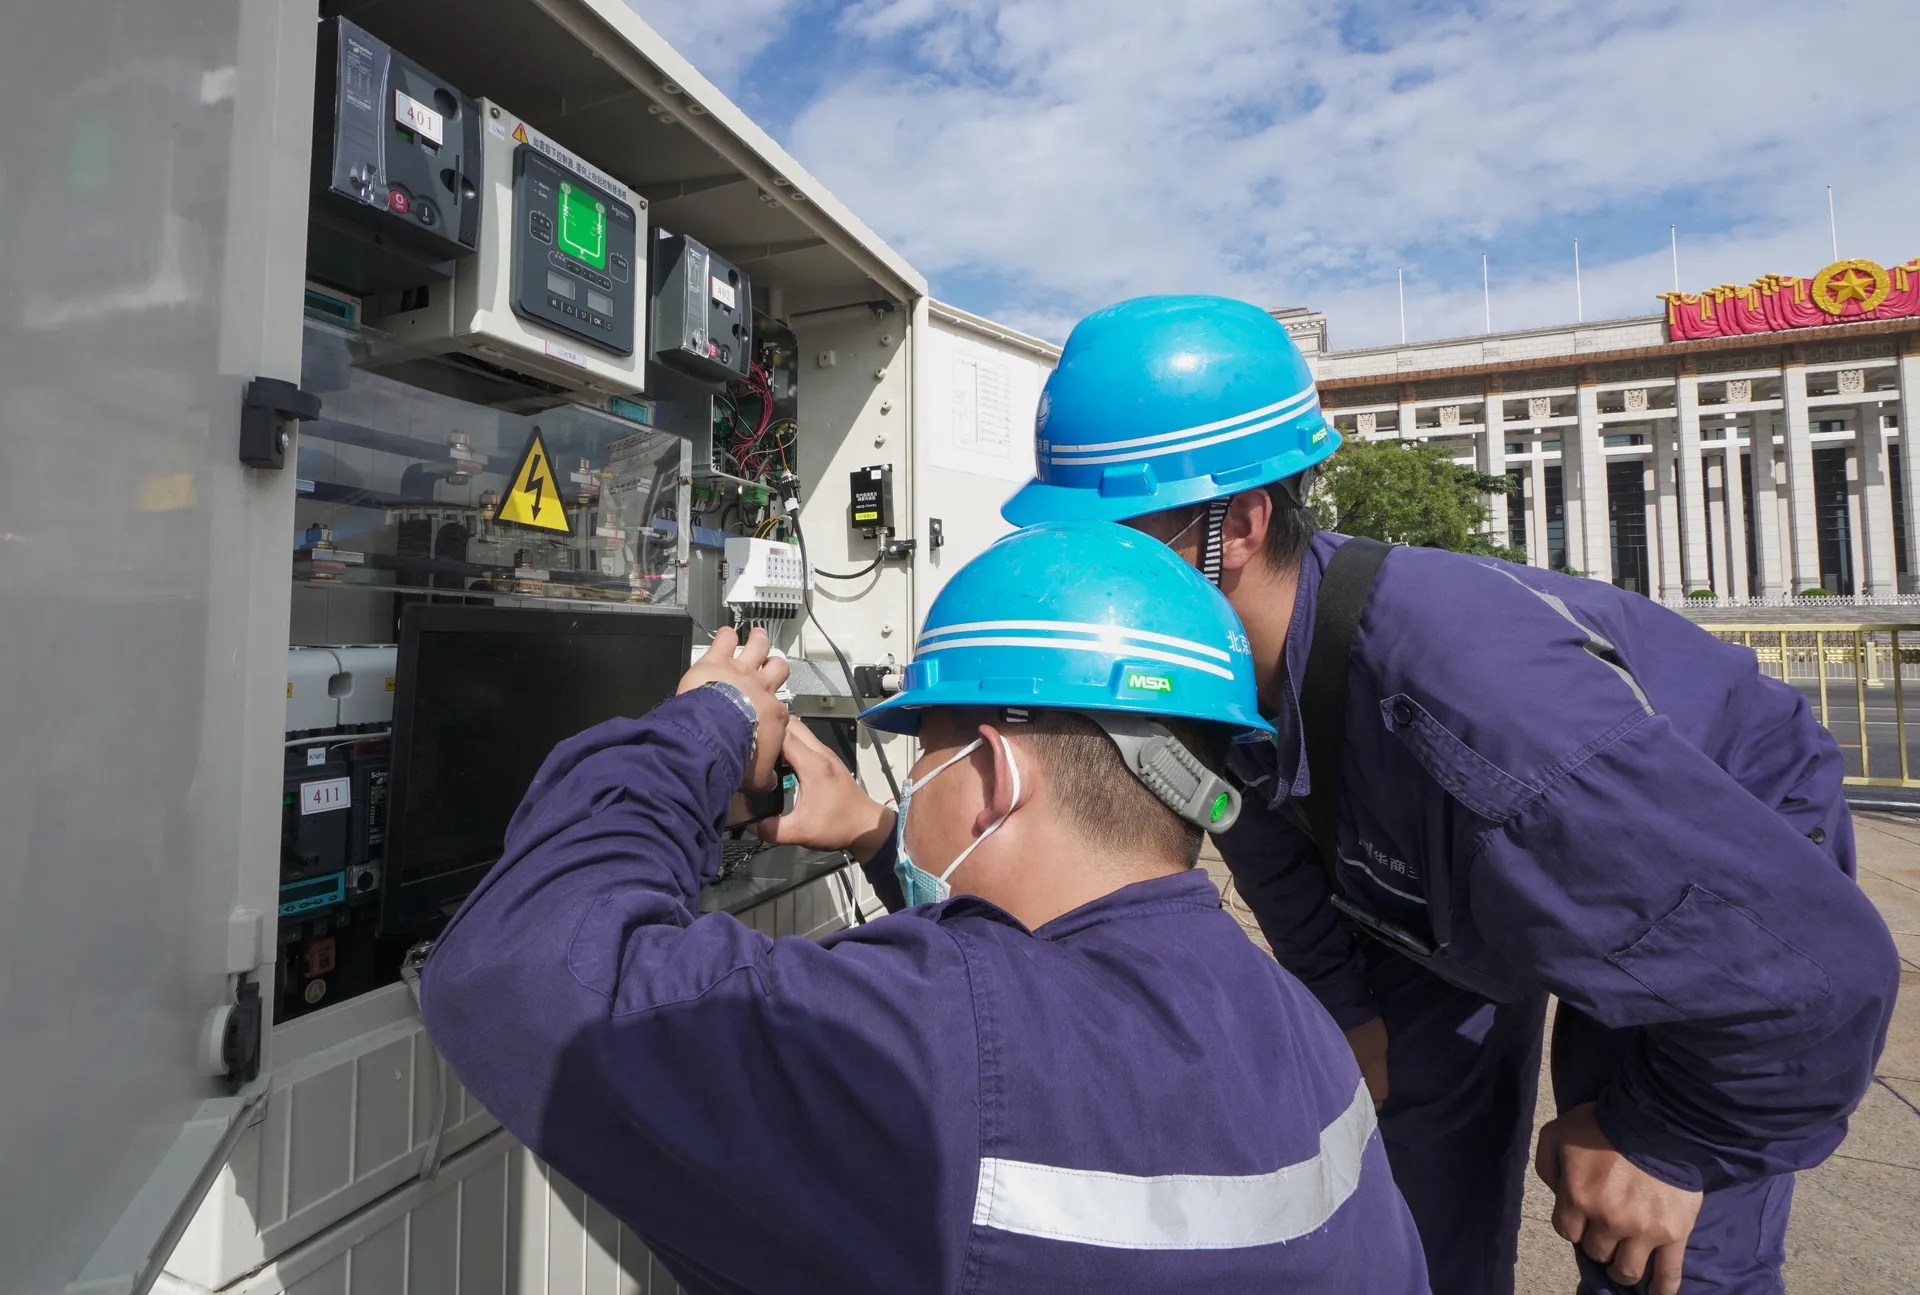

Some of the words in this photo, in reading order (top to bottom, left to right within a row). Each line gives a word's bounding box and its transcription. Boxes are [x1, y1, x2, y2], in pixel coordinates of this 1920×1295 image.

[407, 106, 432, 131] 401
[1129, 674, 1171, 692] MSA
[313, 786, 340, 804] 411
